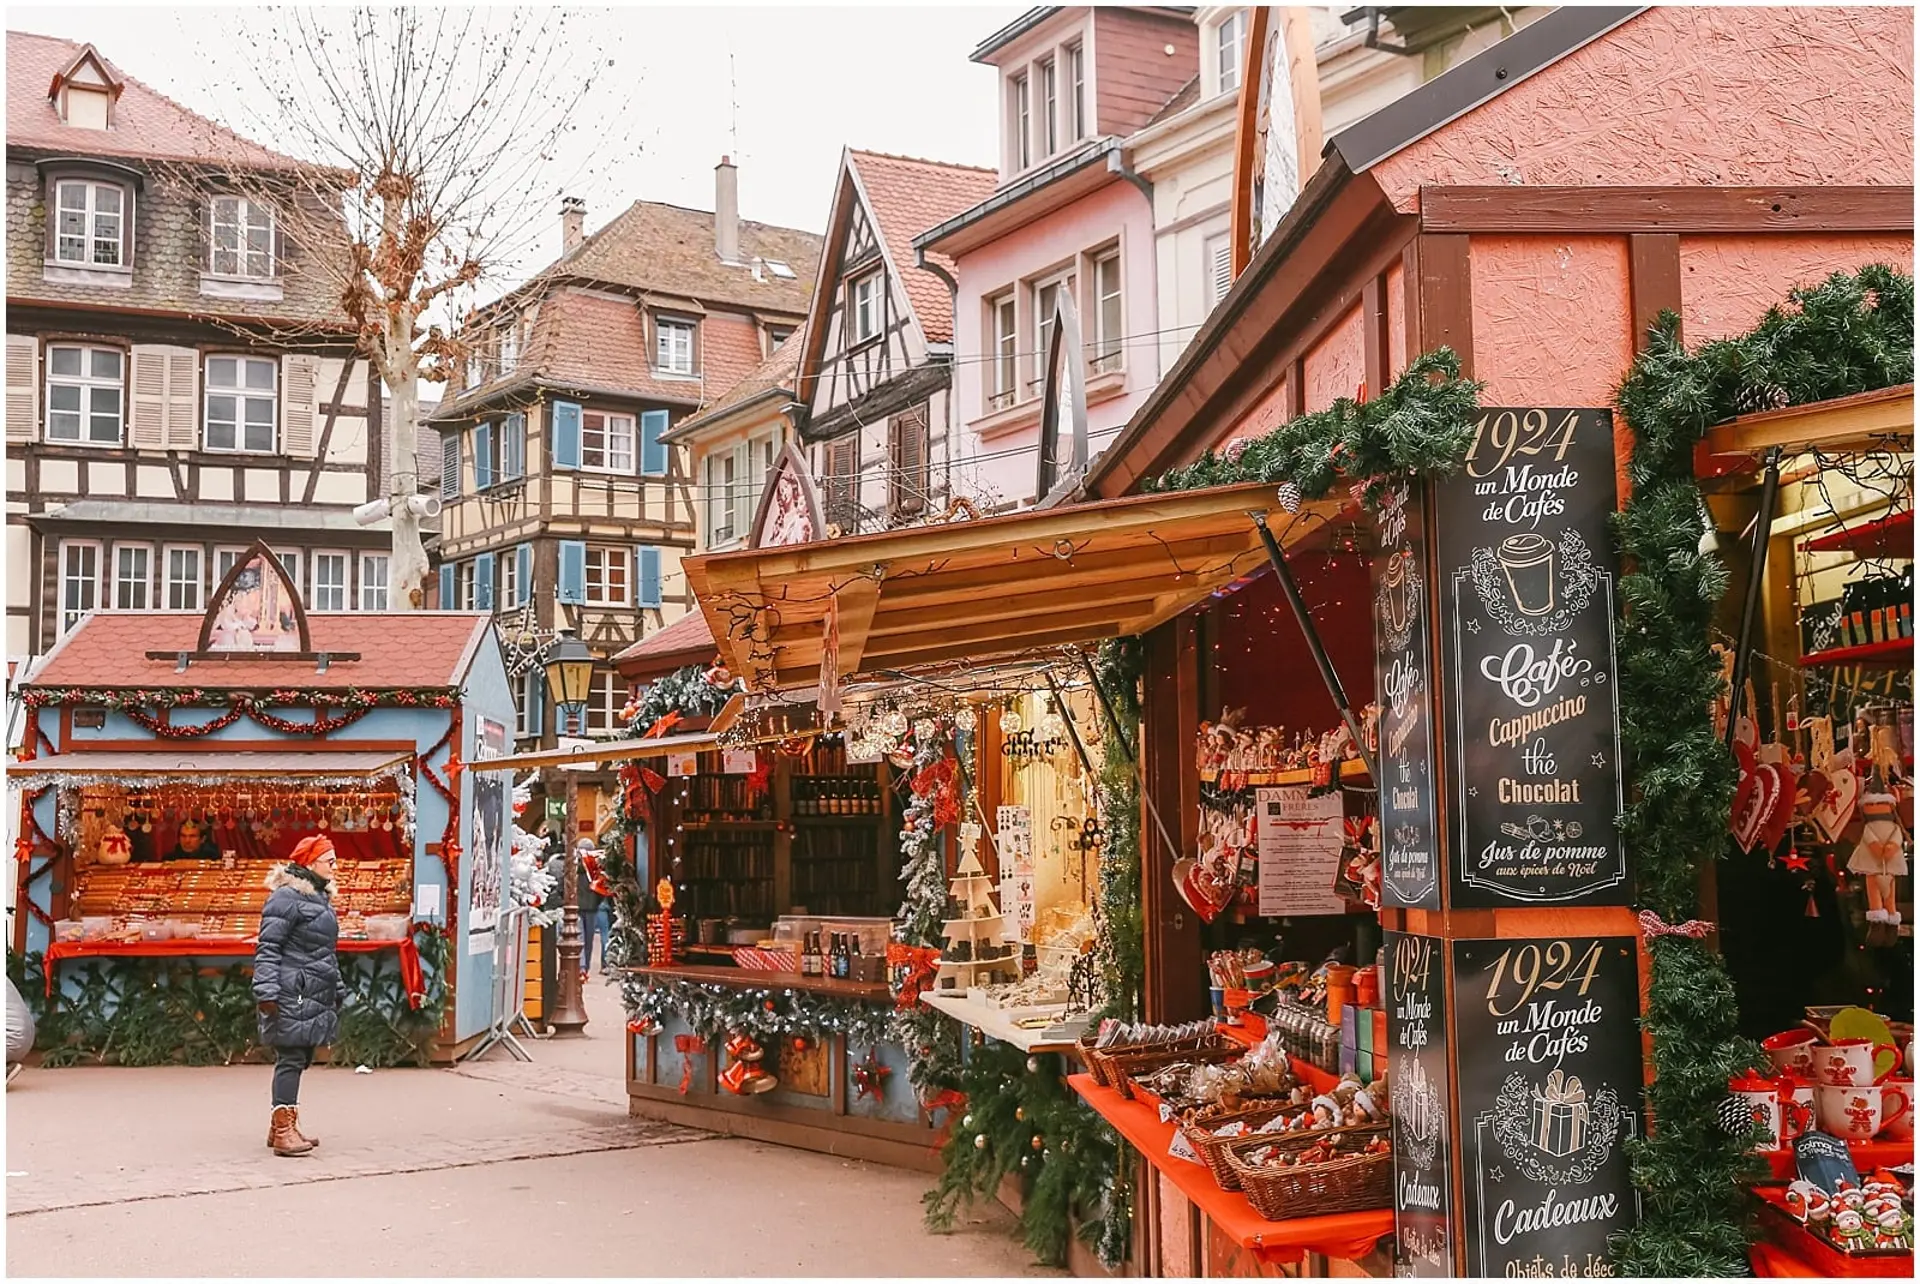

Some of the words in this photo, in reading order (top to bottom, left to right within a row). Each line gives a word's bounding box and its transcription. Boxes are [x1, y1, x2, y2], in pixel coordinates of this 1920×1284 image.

[1464, 408, 1580, 479] 1924
[1474, 482, 1497, 496] un
[1499, 464, 1579, 495] Monde
[1483, 504, 1503, 521] de
[1504, 490, 1565, 530] Cafés
[1384, 650, 1419, 719] Café
[1480, 638, 1592, 707] Café
[1489, 694, 1587, 749] Cappuccino
[1521, 737, 1558, 775] thé
[1392, 786, 1419, 810] Chocolat
[1498, 777, 1581, 804] Chocolat
[1478, 840, 1517, 869] Jus
[1519, 841, 1542, 860] de
[1543, 844, 1608, 867] pomme
[1495, 866, 1518, 876] aux
[1520, 863, 1550, 878] épices
[1552, 862, 1565, 875] de
[1567, 861, 1598, 878] Noël
[1392, 936, 1431, 1002] 1924
[1483, 940, 1604, 1017] 1924
[1405, 992, 1432, 1021] Monde
[1497, 1019, 1520, 1035] un
[1521, 998, 1602, 1034] Monde
[1400, 1027, 1407, 1045] de
[1406, 1019, 1428, 1058] Cafés
[1505, 1042, 1526, 1061] de
[1527, 1025, 1589, 1069] Cafés
[1399, 1170, 1441, 1211] Cadeaux
[1494, 1189, 1619, 1244] Cadeaux
[1560, 1254, 1578, 1278] de
